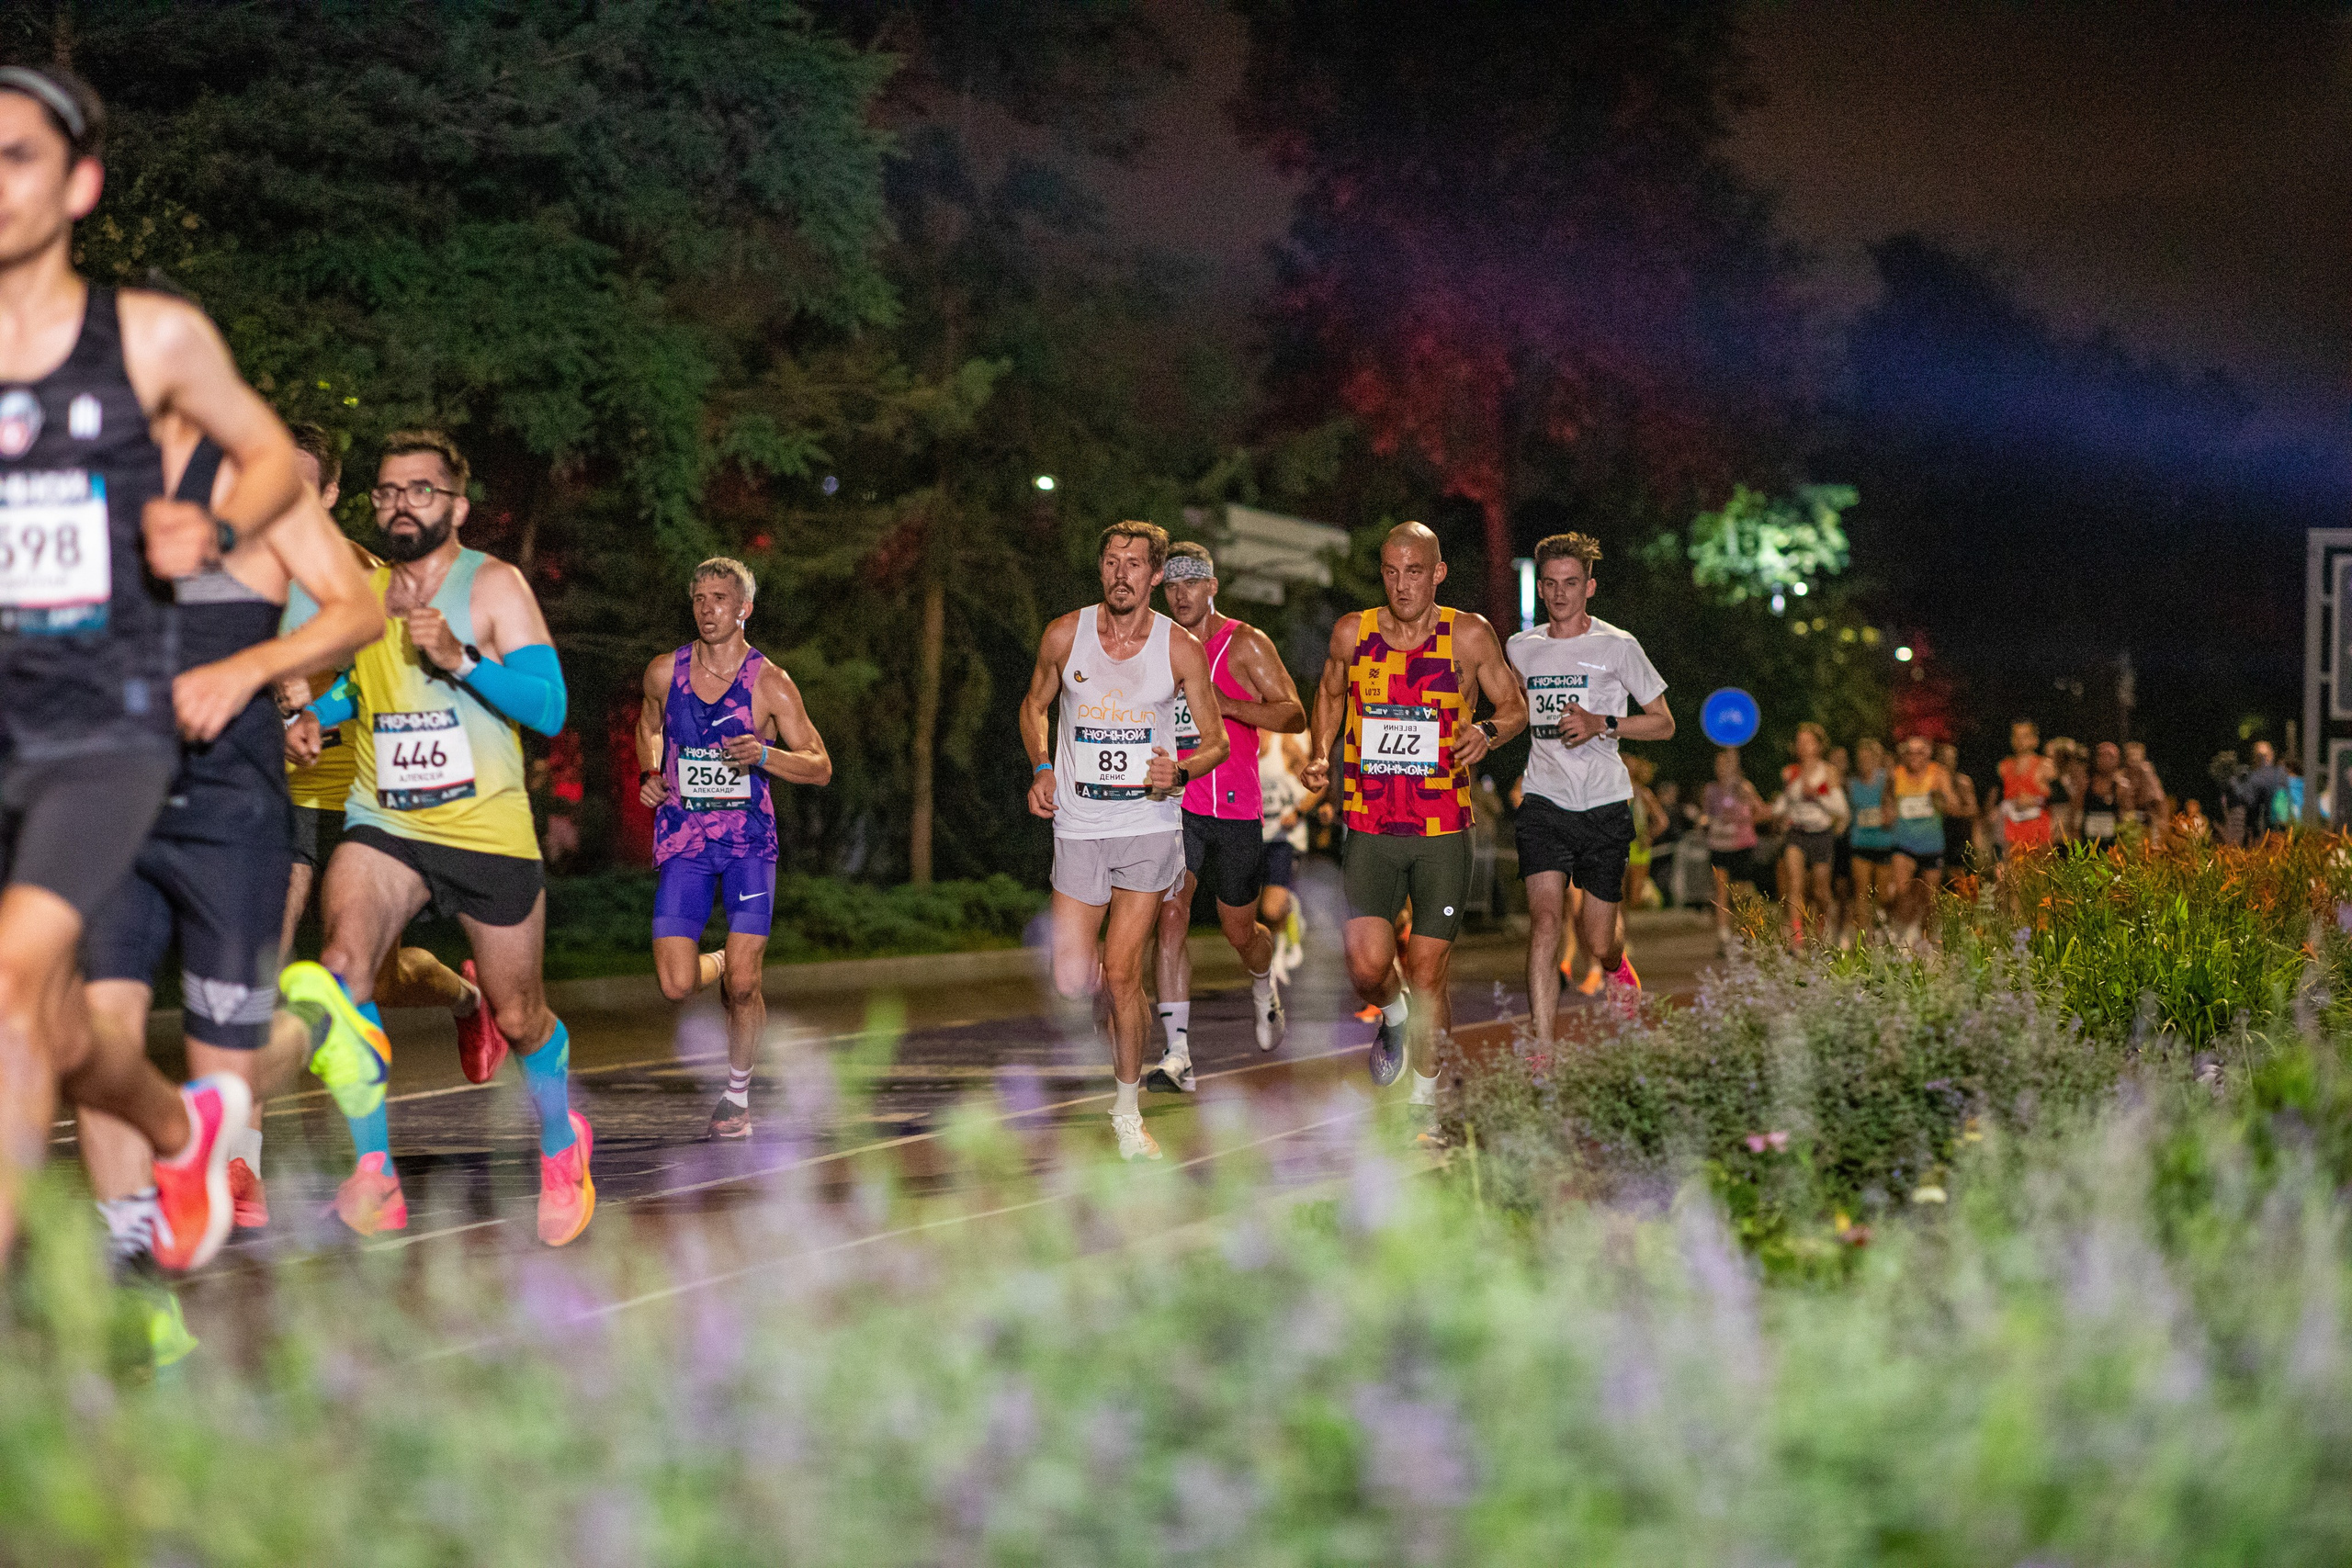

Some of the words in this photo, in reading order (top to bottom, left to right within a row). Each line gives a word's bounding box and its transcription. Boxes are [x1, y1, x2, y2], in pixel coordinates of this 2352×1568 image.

[1078, 694, 1157, 724] parkrun
[1082, 728, 1148, 741] НОЧНОЙ
[1384, 724, 1418, 732] ЕВГЕНИЙ
[393, 740, 447, 770] 446
[1377, 733, 1421, 755] 277
[1098, 750, 1127, 772] 83
[687, 766, 741, 785] 2562
